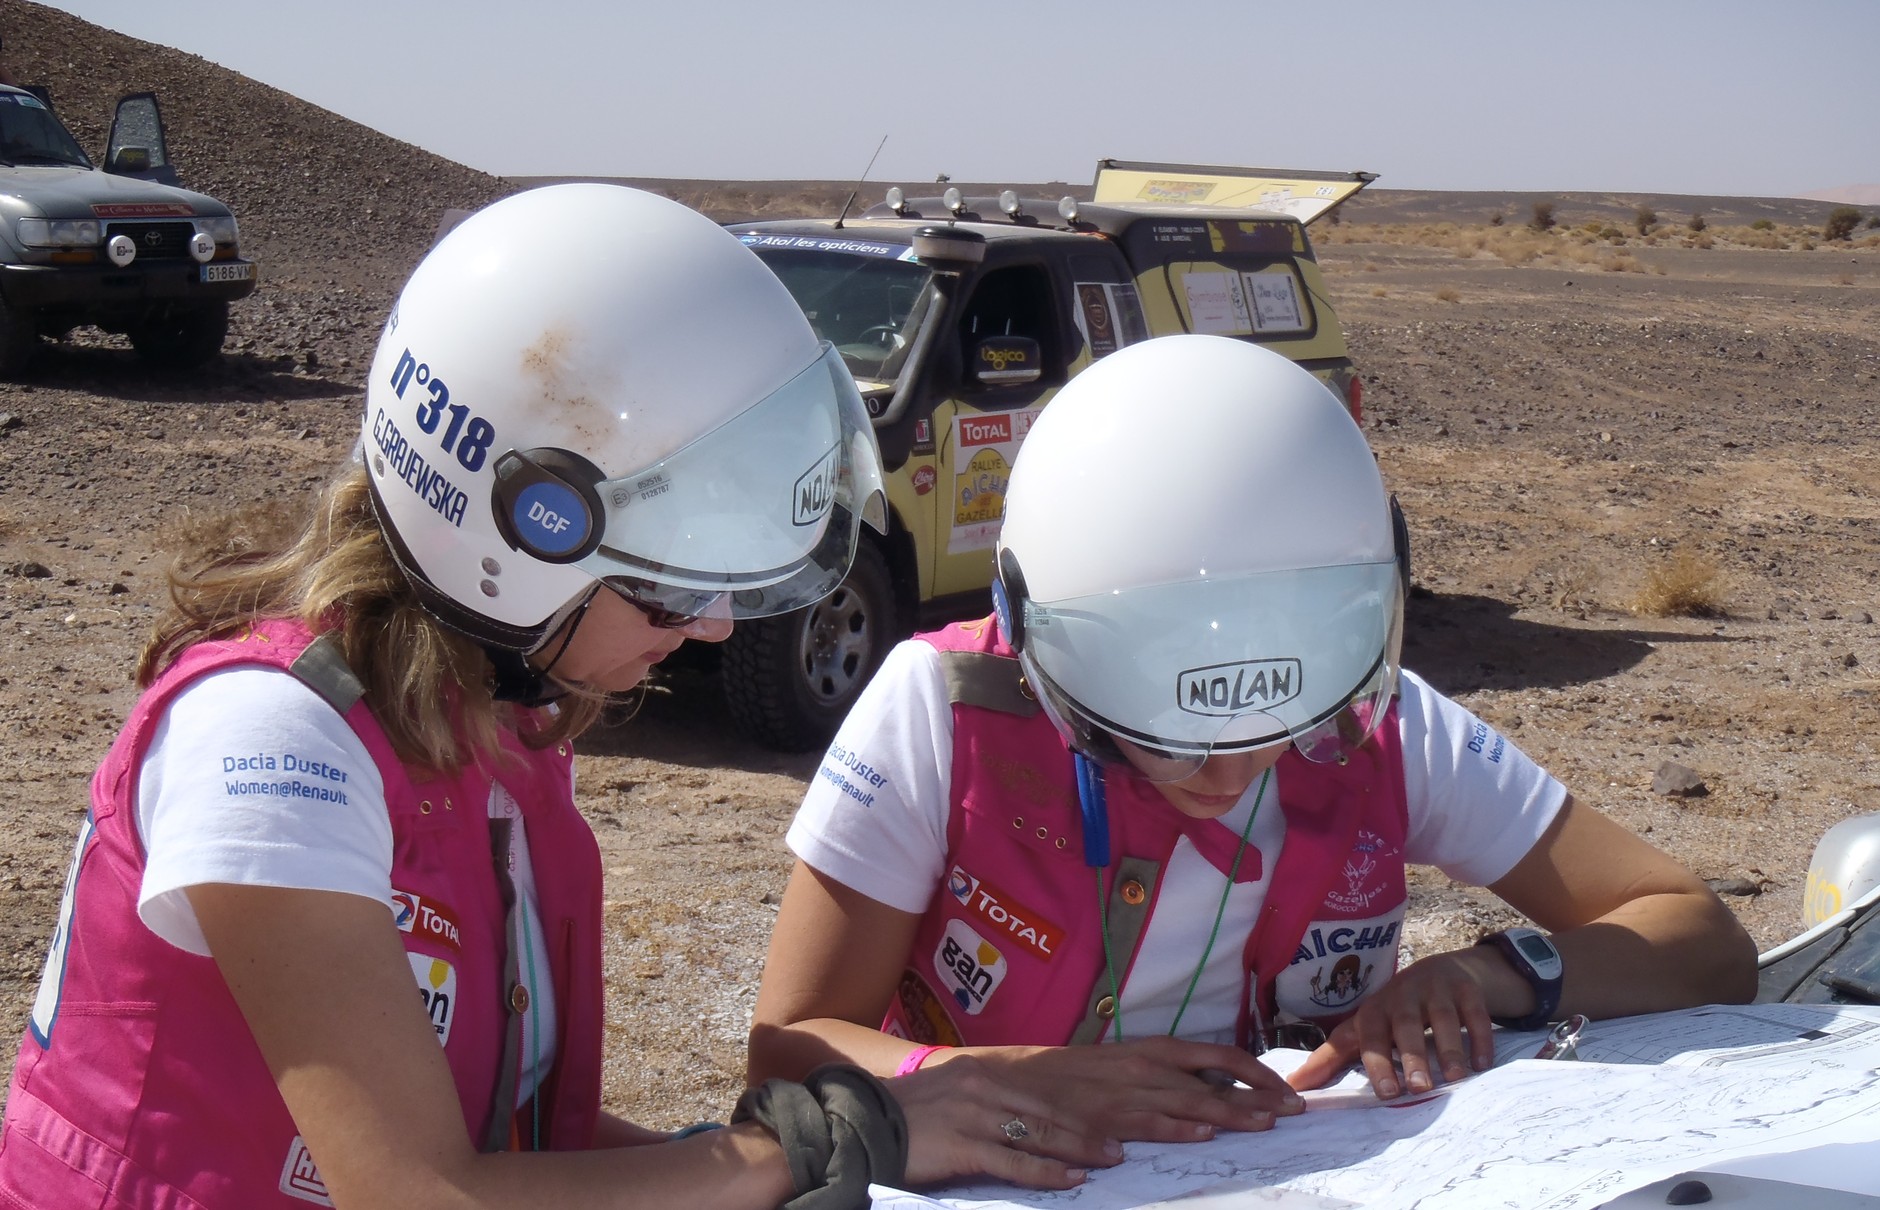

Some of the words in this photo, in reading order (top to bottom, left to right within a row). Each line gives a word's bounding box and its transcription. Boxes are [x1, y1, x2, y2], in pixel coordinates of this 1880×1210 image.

[760, 236, 791, 246] Atol
[793, 238, 816, 248] les
[818, 240, 890, 255] opticiens
[963, 423, 1009, 441] TOTAL
[971, 458, 1002, 472] RALLYE
[527, 501, 571, 535] DCF
[1189, 666, 1291, 711] NOLAN
[222, 753, 277, 773] Dacia
[283, 754, 348, 784] Duster
[844, 751, 888, 789] Duster
[225, 780, 349, 806] Women@Renault
[974, 890, 1051, 954] TOTAL
[1290, 921, 1400, 966] AICHA
[942, 936, 993, 997] gan
